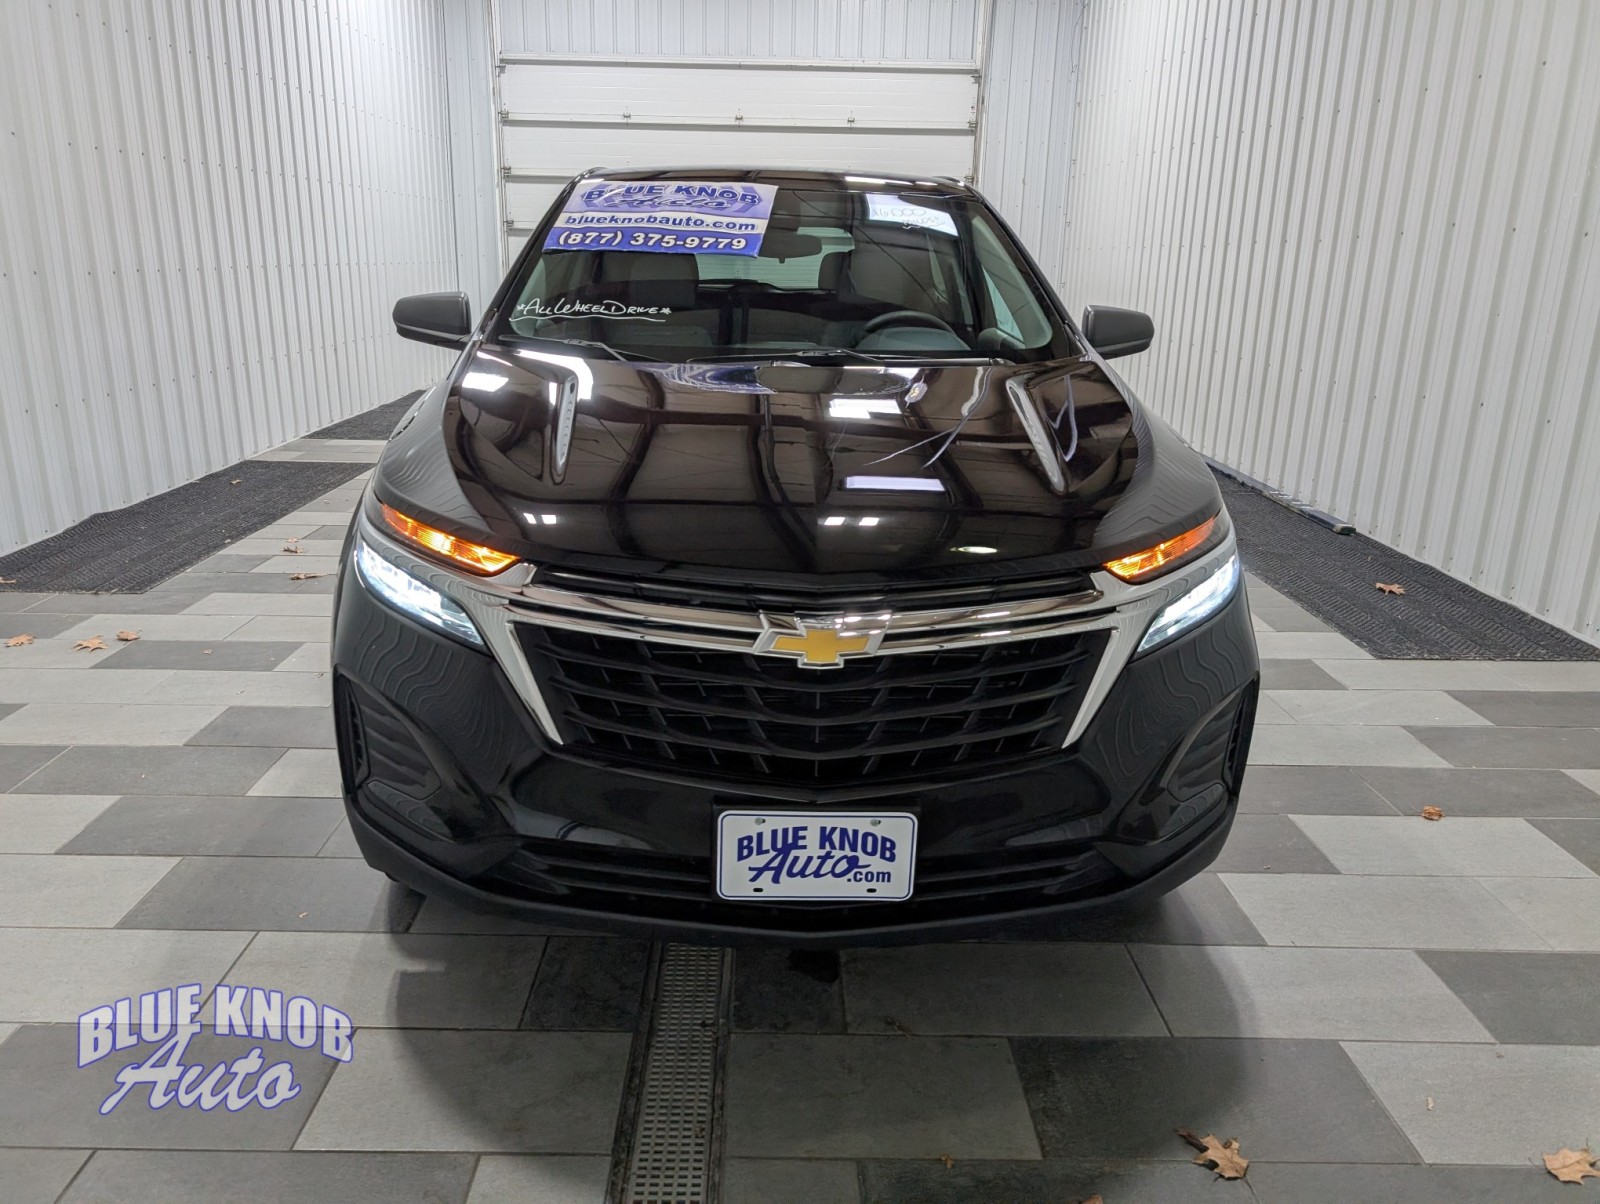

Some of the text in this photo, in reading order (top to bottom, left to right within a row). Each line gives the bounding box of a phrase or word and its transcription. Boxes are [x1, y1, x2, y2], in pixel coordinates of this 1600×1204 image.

[585, 185, 763, 205] BUE KNOB
[565, 214, 756, 232] blueknobauto.com
[558, 231, 747, 250] (877) 375-9779
[737, 825, 896, 862] BLUE KNOB
